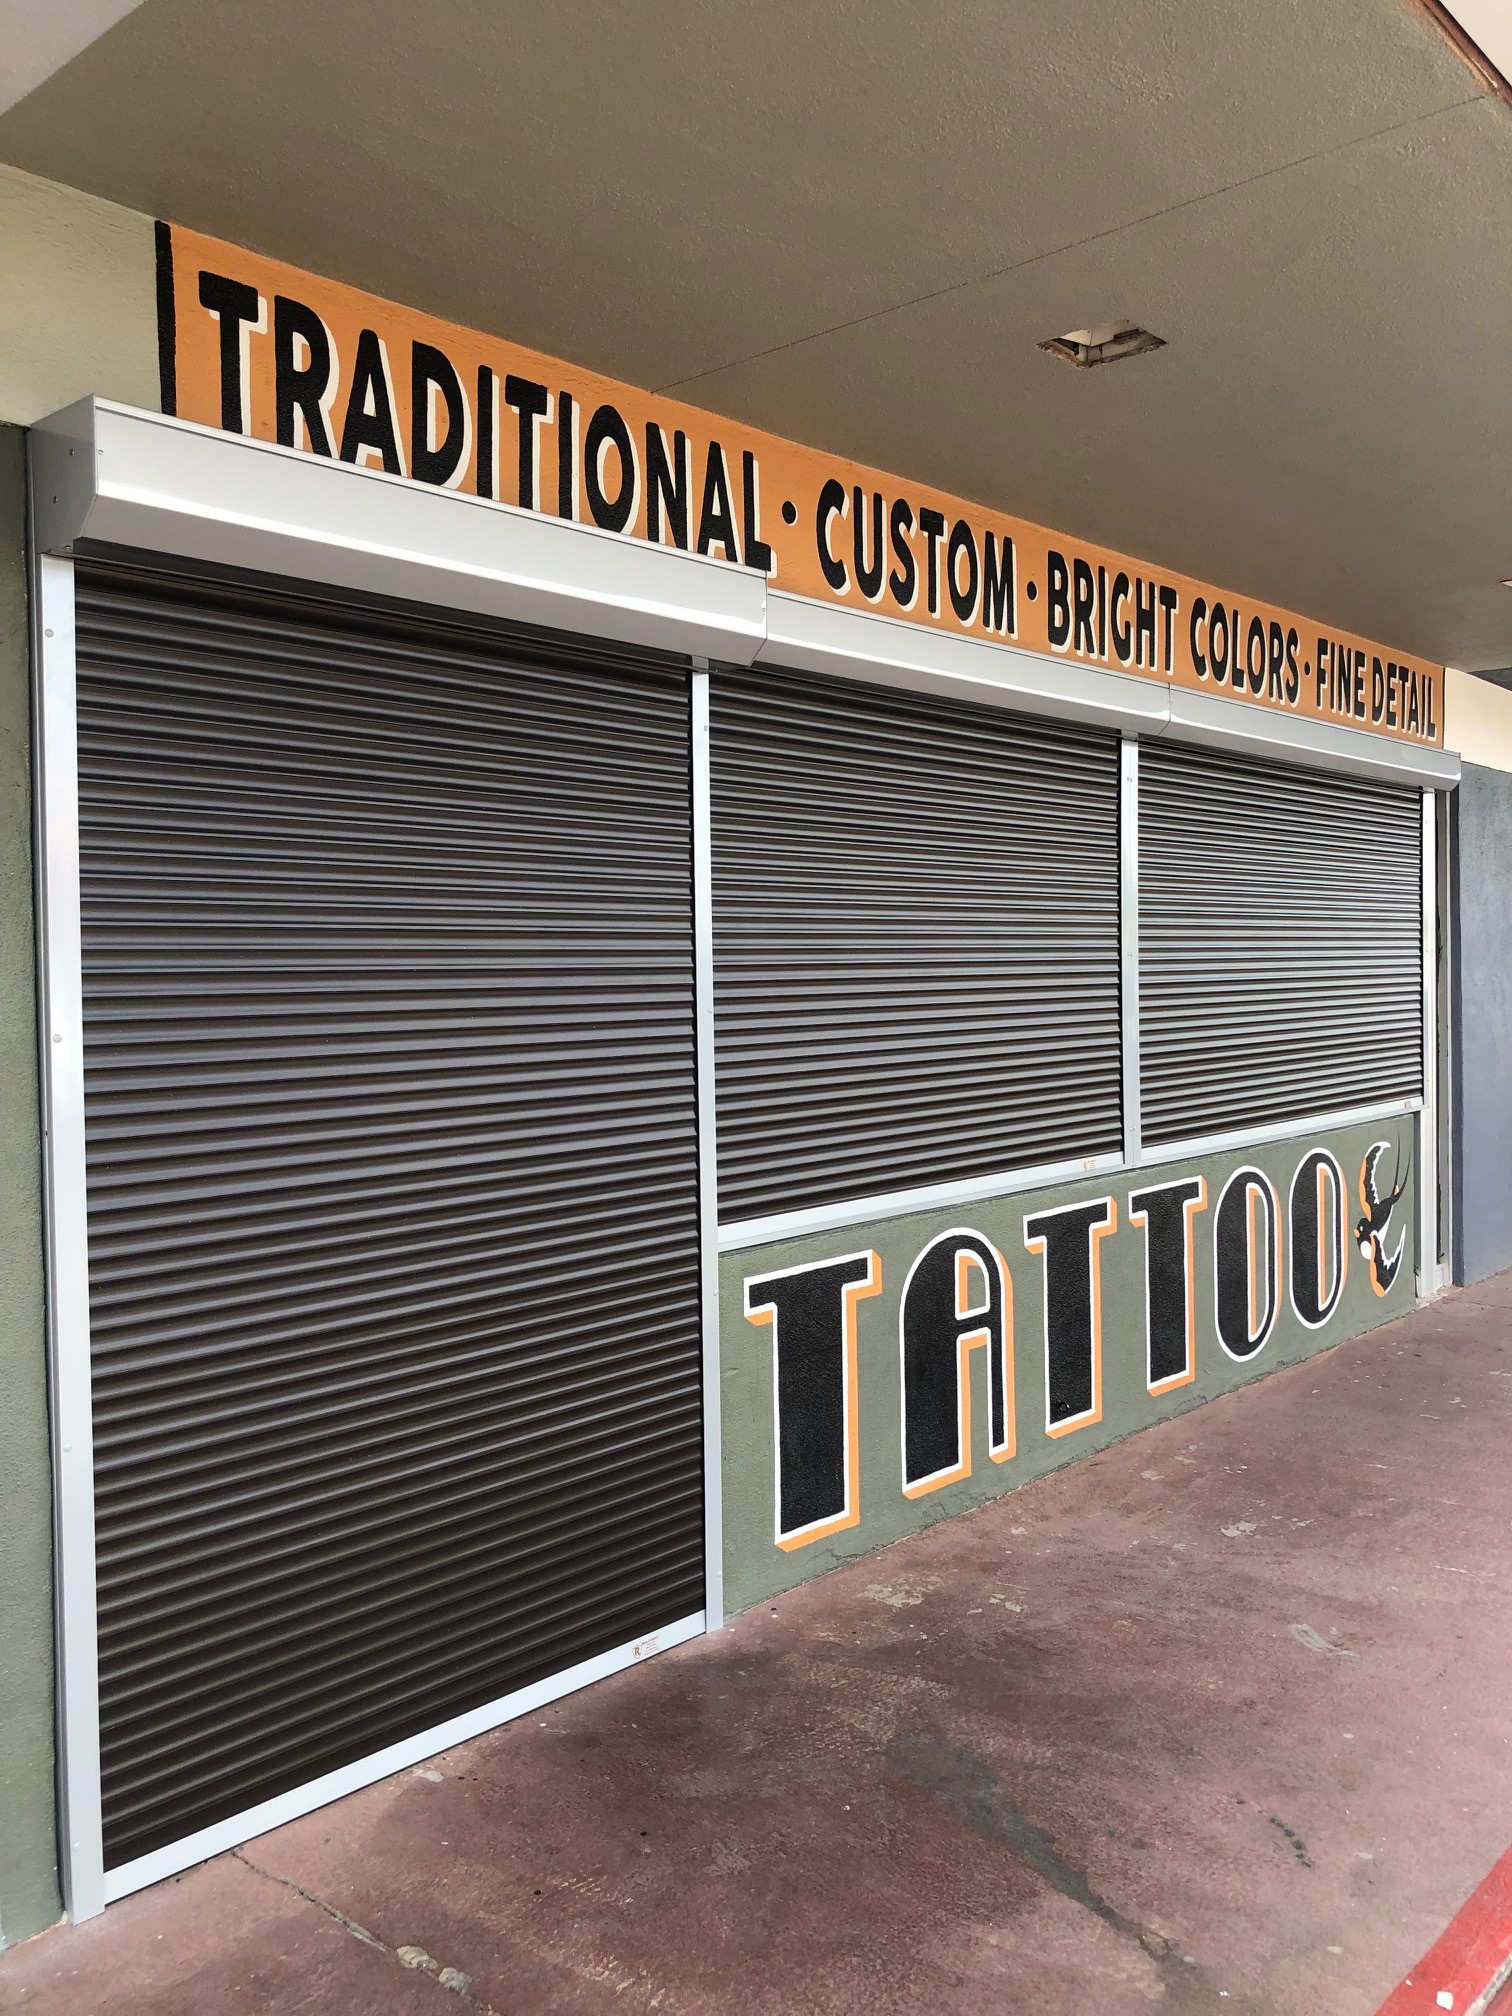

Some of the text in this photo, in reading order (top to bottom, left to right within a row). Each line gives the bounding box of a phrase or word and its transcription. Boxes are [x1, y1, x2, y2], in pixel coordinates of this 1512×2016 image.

[199, 270, 1437, 742] TRADITIONAL CUSTOM BRIGHT COLORS FINE DETAIL
[744, 1146, 1348, 1553] TATTOO
